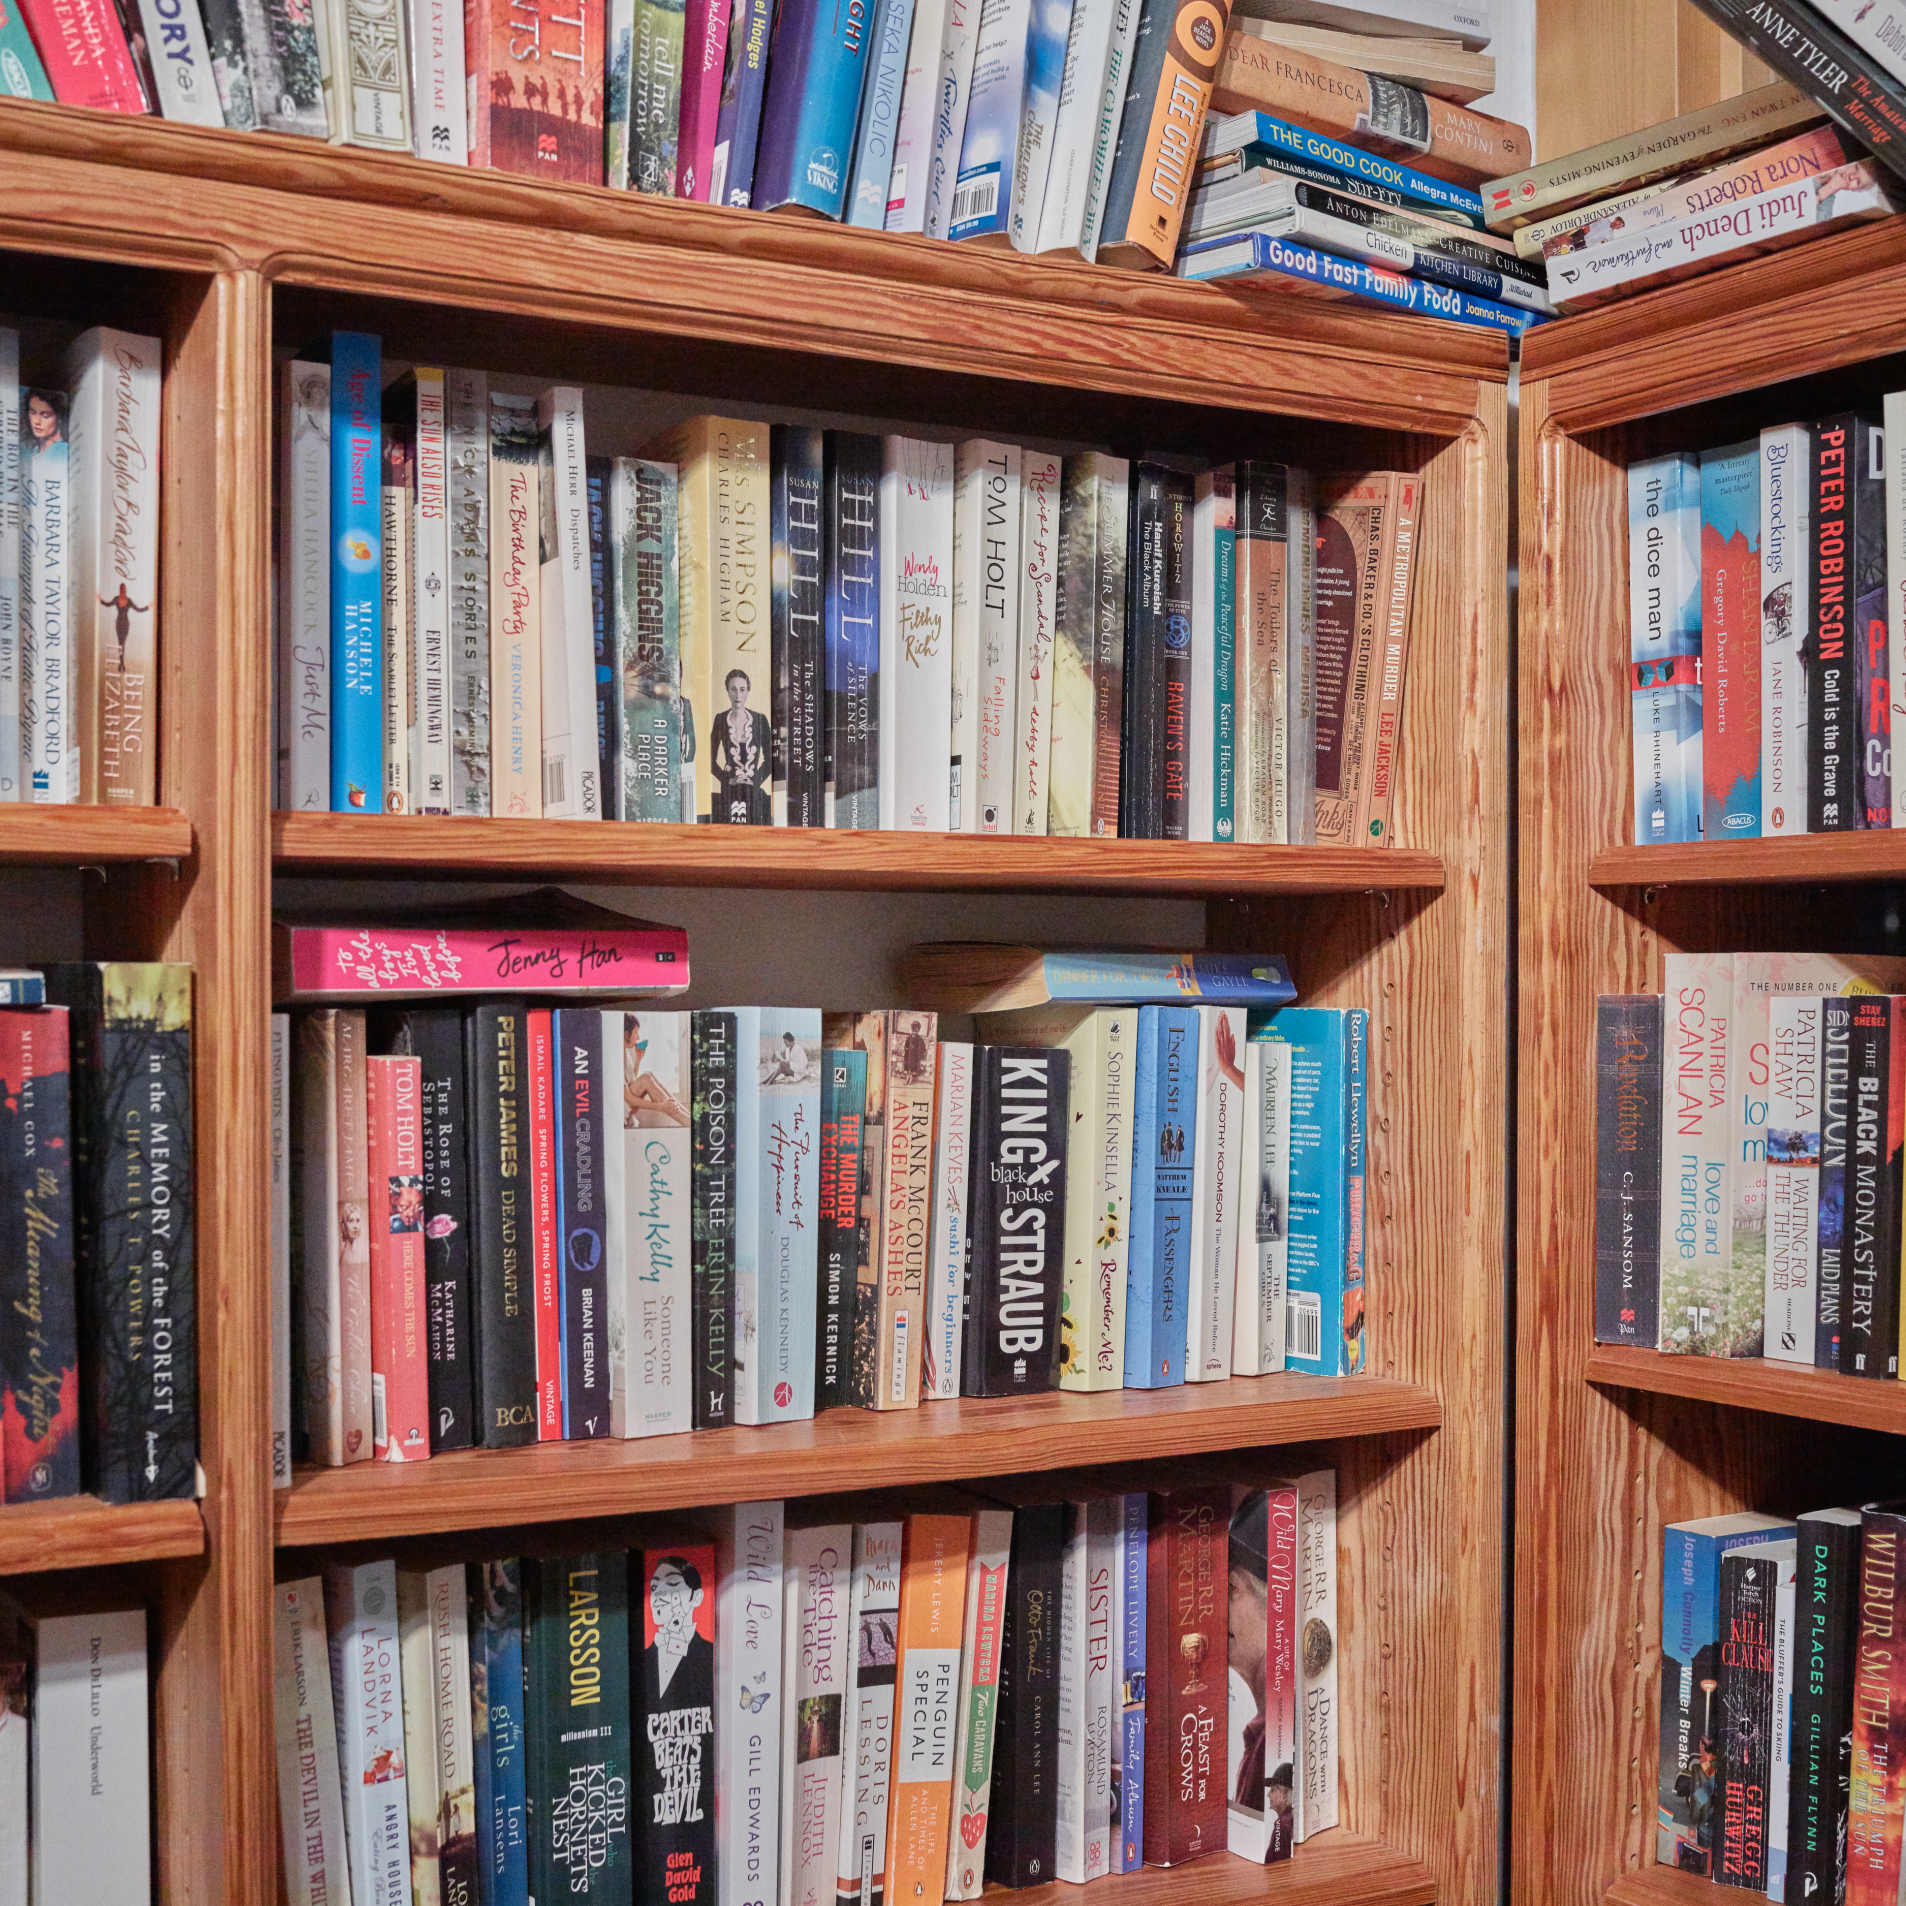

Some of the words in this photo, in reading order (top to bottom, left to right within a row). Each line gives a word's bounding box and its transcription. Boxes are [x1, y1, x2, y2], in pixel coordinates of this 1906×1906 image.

[747, 19, 767, 70] Hodges
[1453, 14, 1481, 27] OXFORD
[1746, 0, 1796, 49] ANNE
[1794, 38, 1849, 94] TYLER
[653, 35, 675, 79] tell
[1227, 48, 1269, 72] DEAR
[1275, 60, 1365, 103] FRANCESCA
[651, 86, 668, 124] me
[868, 65, 897, 158] NIKOLIC
[1167, 74, 1200, 126] LEE
[1851, 75, 1872, 100] The
[1435, 124, 1494, 156] CONTINI
[1446, 112, 1482, 133] MARY
[1648, 129, 1700, 155] GARDEN
[1845, 101, 1892, 144] Marriage
[538, 151, 558, 161] PAN
[806, 170, 838, 195] VIKING
[1151, 124, 1189, 206] CHILD
[1266, 158, 1341, 185] WILLIAMS-SONOMA
[1346, 177, 1401, 208] Stir-Fry
[1269, 123, 1304, 150] THE
[1307, 139, 1355, 167] GOOD
[1359, 158, 1404, 187] COOK
[1410, 178, 1447, 201] Allegra
[1549, 167, 1581, 188] MISTS
[1584, 153, 1633, 178] EVENING
[1768, 148, 1821, 183] Nora
[1687, 169, 1763, 214] Roberts
[1758, 190, 1808, 227] Judi
[1681, 210, 1753, 251] Dench
[1270, 242, 1317, 277] Good
[1323, 256, 1359, 286] Fast
[1366, 267, 1418, 308] Family
[1424, 282, 1461, 316] Food
[1465, 303, 1495, 324] Joanna
[1496, 310, 1522, 328] Farrow
[1366, 231, 1408, 259] Chicken
[1420, 251, 1460, 279] KITCHEN
[1463, 265, 1499, 290] LIBRARY
[421, 394, 443, 414] THE
[421, 419, 443, 443] SUN
[421, 447, 443, 479] ALSO
[987, 455, 1008, 526] TOM
[1820, 429, 1845, 512] PETER
[44, 479, 61, 568] BARBARA
[421, 483, 443, 519] RISES
[636, 467, 662, 544] JACK
[1646, 478, 1662, 517] the
[1766, 443, 1789, 574] Bluestockings
[569, 508, 580, 571] Dispatches
[1143, 521, 1153, 539] The
[1143, 542, 1153, 569] Black
[1153, 521, 1163, 556] Hanif
[1647, 527, 1663, 577] dice
[789, 492, 819, 637] HILL
[841, 487, 874, 641] HILL
[985, 539, 1006, 618] HOLT
[1143, 571, 1153, 608] Album
[1153, 557, 1163, 616] Kureishi
[1389, 531, 1411, 637] METROPOLITAN
[1819, 520, 1845, 660] ROBINSON
[45, 576, 61, 651] TAYLOR
[636, 551, 664, 663] HIGGINS
[1648, 588, 1663, 641] man
[345, 605, 359, 689] HANSON
[359, 600, 373, 696] MICHELE
[1383, 643, 1401, 700] MURDER
[45, 658, 61, 765] BRADFORD
[122, 674, 144, 753] BEING
[1824, 669, 1840, 702] Cold
[1167, 681, 1184, 752] RAVEN'S
[1379, 712, 1394, 738] LEE
[1824, 707, 1840, 722] is
[1824, 724, 1840, 750] the
[637, 734, 650, 780] PLACE
[654, 735, 668, 797] DARKER
[1165, 760, 1183, 801] GATE
[1374, 741, 1391, 797] JACKSON
[1824, 755, 1840, 797] Grave
[582, 771, 597, 813] PICADOR
[488, 938, 567, 977] Jenny
[578, 940, 623, 978] Han
[1854, 1015, 1886, 1027] SHEREZ
[1860, 1005, 1881, 1015] STAV
[150, 1054, 165, 1073] in
[497, 1016, 515, 1090] PETER
[574, 1047, 588, 1074] AN
[709, 1022, 725, 1066] THE
[1350, 1012, 1362, 1073] Robert
[1678, 988, 1705, 1135] SCANLAN
[1709, 1017, 1727, 1109] PATRICIA
[1775, 1028, 1794, 1099] SHAW
[1796, 1009, 1816, 1120] PATRICIA
[1865, 1041, 1877, 1069] THE
[150, 1082, 167, 1113] the
[575, 1080, 590, 1119] EVIL
[709, 1078, 726, 1165] POISON
[1001, 1058, 1049, 1164] KING
[1349, 1081, 1361, 1167] Llewellyn
[1856, 1077, 1878, 1155] BLACK
[498, 1096, 518, 1179] JAMES
[840, 1113, 860, 1145] THE
[890, 1101, 908, 1210] ANGELA'S
[909, 1101, 928, 1176] FRANK
[151, 1123, 171, 1239] MEMORY
[577, 1120, 593, 1212] CRADLING
[820, 1123, 839, 1219] EXCHANGE
[838, 1151, 859, 1228] MURDER
[991, 1160, 1027, 1183] black
[1704, 1162, 1725, 1216] love
[501, 1189, 515, 1242] DEAD
[709, 1175, 725, 1229] TREE
[1006, 1186, 1054, 1204] house
[1675, 1154, 1699, 1259] marriage
[152, 1250, 169, 1272] of
[887, 1220, 904, 1297] ASHES
[1622, 1213, 1634, 1288] SANSOM
[1704, 1219, 1720, 1255] and
[1853, 1165, 1877, 1337] MONASTERY
[152, 1277, 168, 1308] the
[503, 1248, 518, 1318] SIMPLE
[708, 1239, 725, 1296] ERIN
[827, 1253, 840, 1305] SIMON
[999, 1208, 1046, 1354] STRAUB
[582, 1288, 593, 1328] BRIAN
[153, 1317, 173, 1415] FOREST
[583, 1332, 595, 1389] KEENAN
[707, 1309, 725, 1378] KELLY
[825, 1314, 839, 1385] KERNICK
[496, 1407, 535, 1427] BCA
[1813, 1545, 1828, 1603] DARK
[1862, 1532, 1897, 1639] WILBUR
[568, 1570, 600, 1707] LARSSON
[1089, 1568, 1109, 1678] SISTER
[1809, 1615, 1825, 1696] PLACES
[912, 1671, 929, 1762] SPECIAL
[931, 1664, 950, 1766] PENGUIN
[1860, 1646, 1893, 1730] SMITH
[647, 1706, 714, 1742] CARTER
[654, 1736, 701, 1768] BEATS
[1808, 1713, 1821, 1785] GILLIAN
[661, 1764, 701, 1794] THE
[749, 1736, 761, 1777] GILL
[857, 1699, 872, 1827] LESSING
[872, 1715, 889, 1806] DORIS
[1181, 1713, 1197, 1801] CROWS
[553, 1796, 570, 1864] NEST
[570, 1766, 588, 1893] HORNETS'
[588, 1762, 606, 1868] KICKED
[607, 1777, 625, 1843] GIRL
[652, 1786, 703, 1825] DEVIL
[748, 1786, 761, 1882] EDWARDS
[1807, 1795, 1818, 1851] FLYNN
[665, 1866, 701, 1887] David
[666, 1851, 694, 1869] Glen
[668, 1884, 696, 1903] Gold
